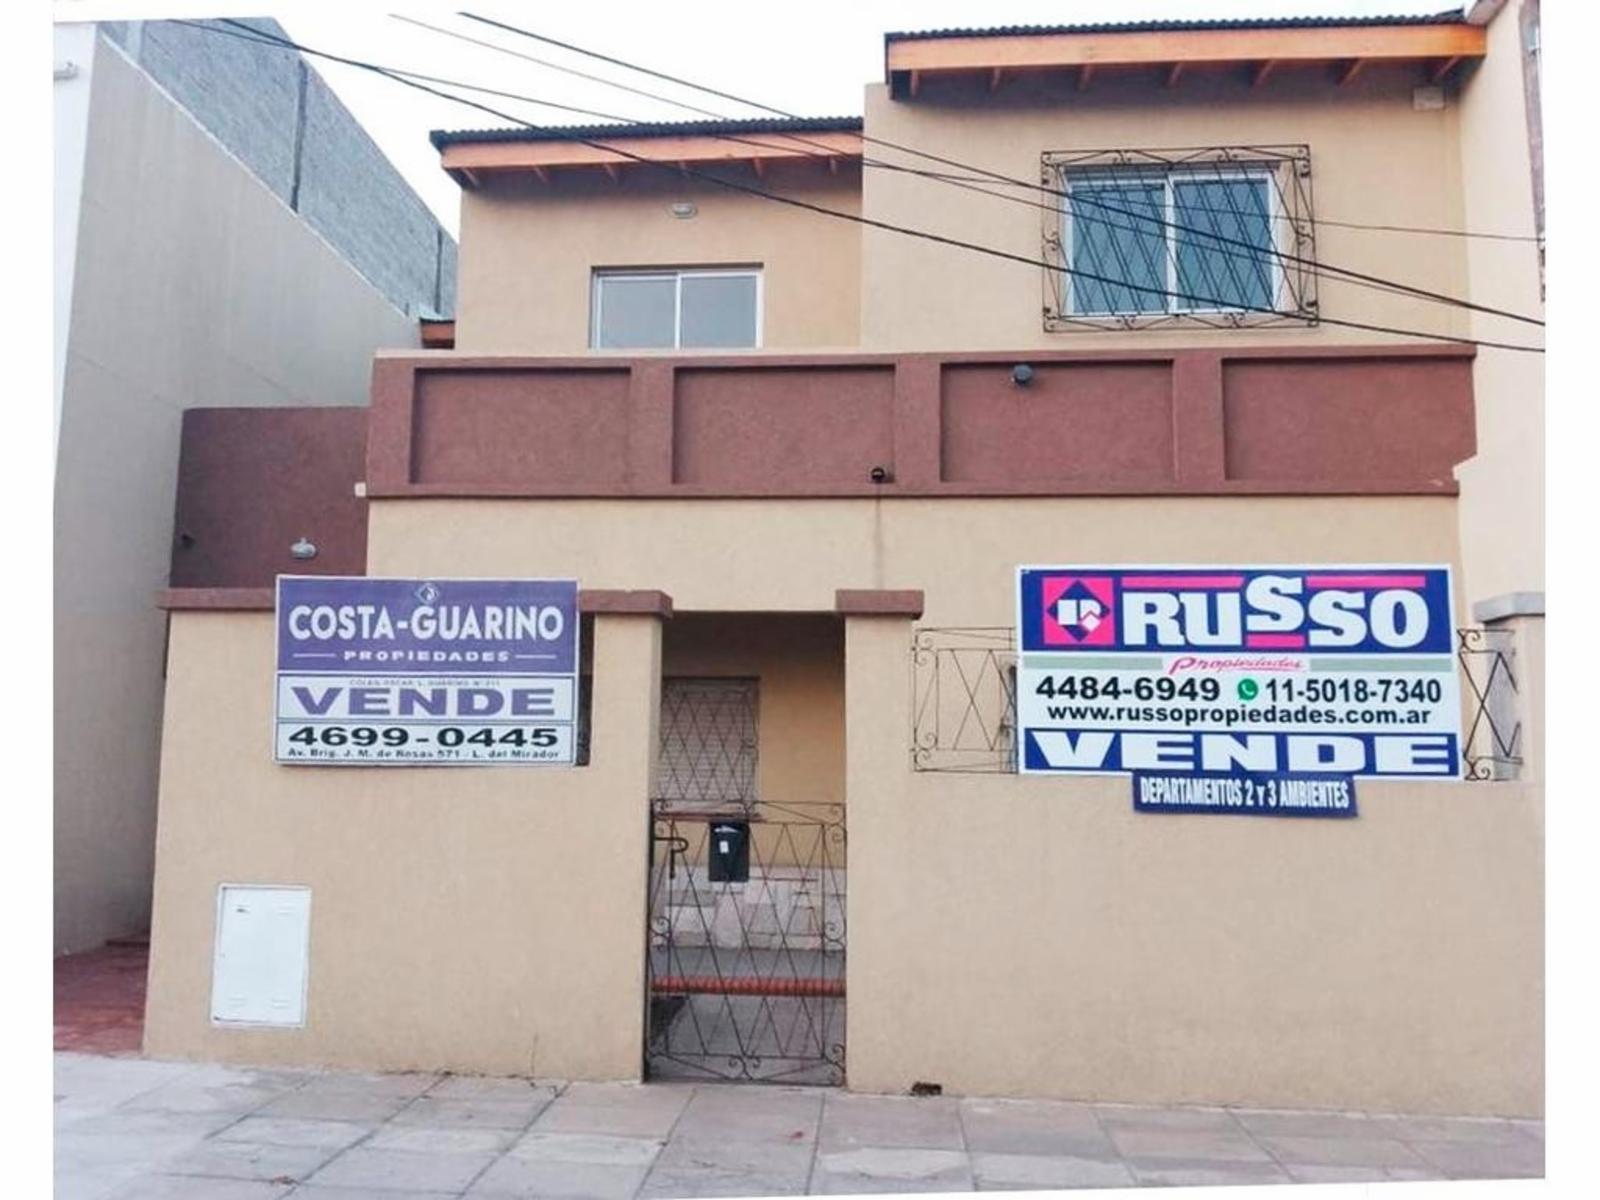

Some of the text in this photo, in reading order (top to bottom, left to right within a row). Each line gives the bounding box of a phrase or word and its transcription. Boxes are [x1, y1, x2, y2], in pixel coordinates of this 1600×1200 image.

[288, 605, 564, 641] COSTA-GUARINO
[344, 650, 511, 662] PROPIEDADES
[1168, 656, 1304, 675] Propiedades
[291, 687, 555, 716] VENDE
[1036, 676, 1442, 703] 4484-6949 11-5018-7340
[1047, 704, 1431, 727] www.russopropiedades.com.ar
[288, 726, 558, 747] 4699-0445
[377, 749, 392, 757] de
[511, 750, 559, 758] Mirador
[1032, 731, 1450, 773] VENDE
[1140, 777, 1244, 806] DEPARTAMENTOS
[1244, 779, 1254, 806] 2
[1267, 780, 1277, 807] 3
[1279, 780, 1350, 808] AMBIENTES
